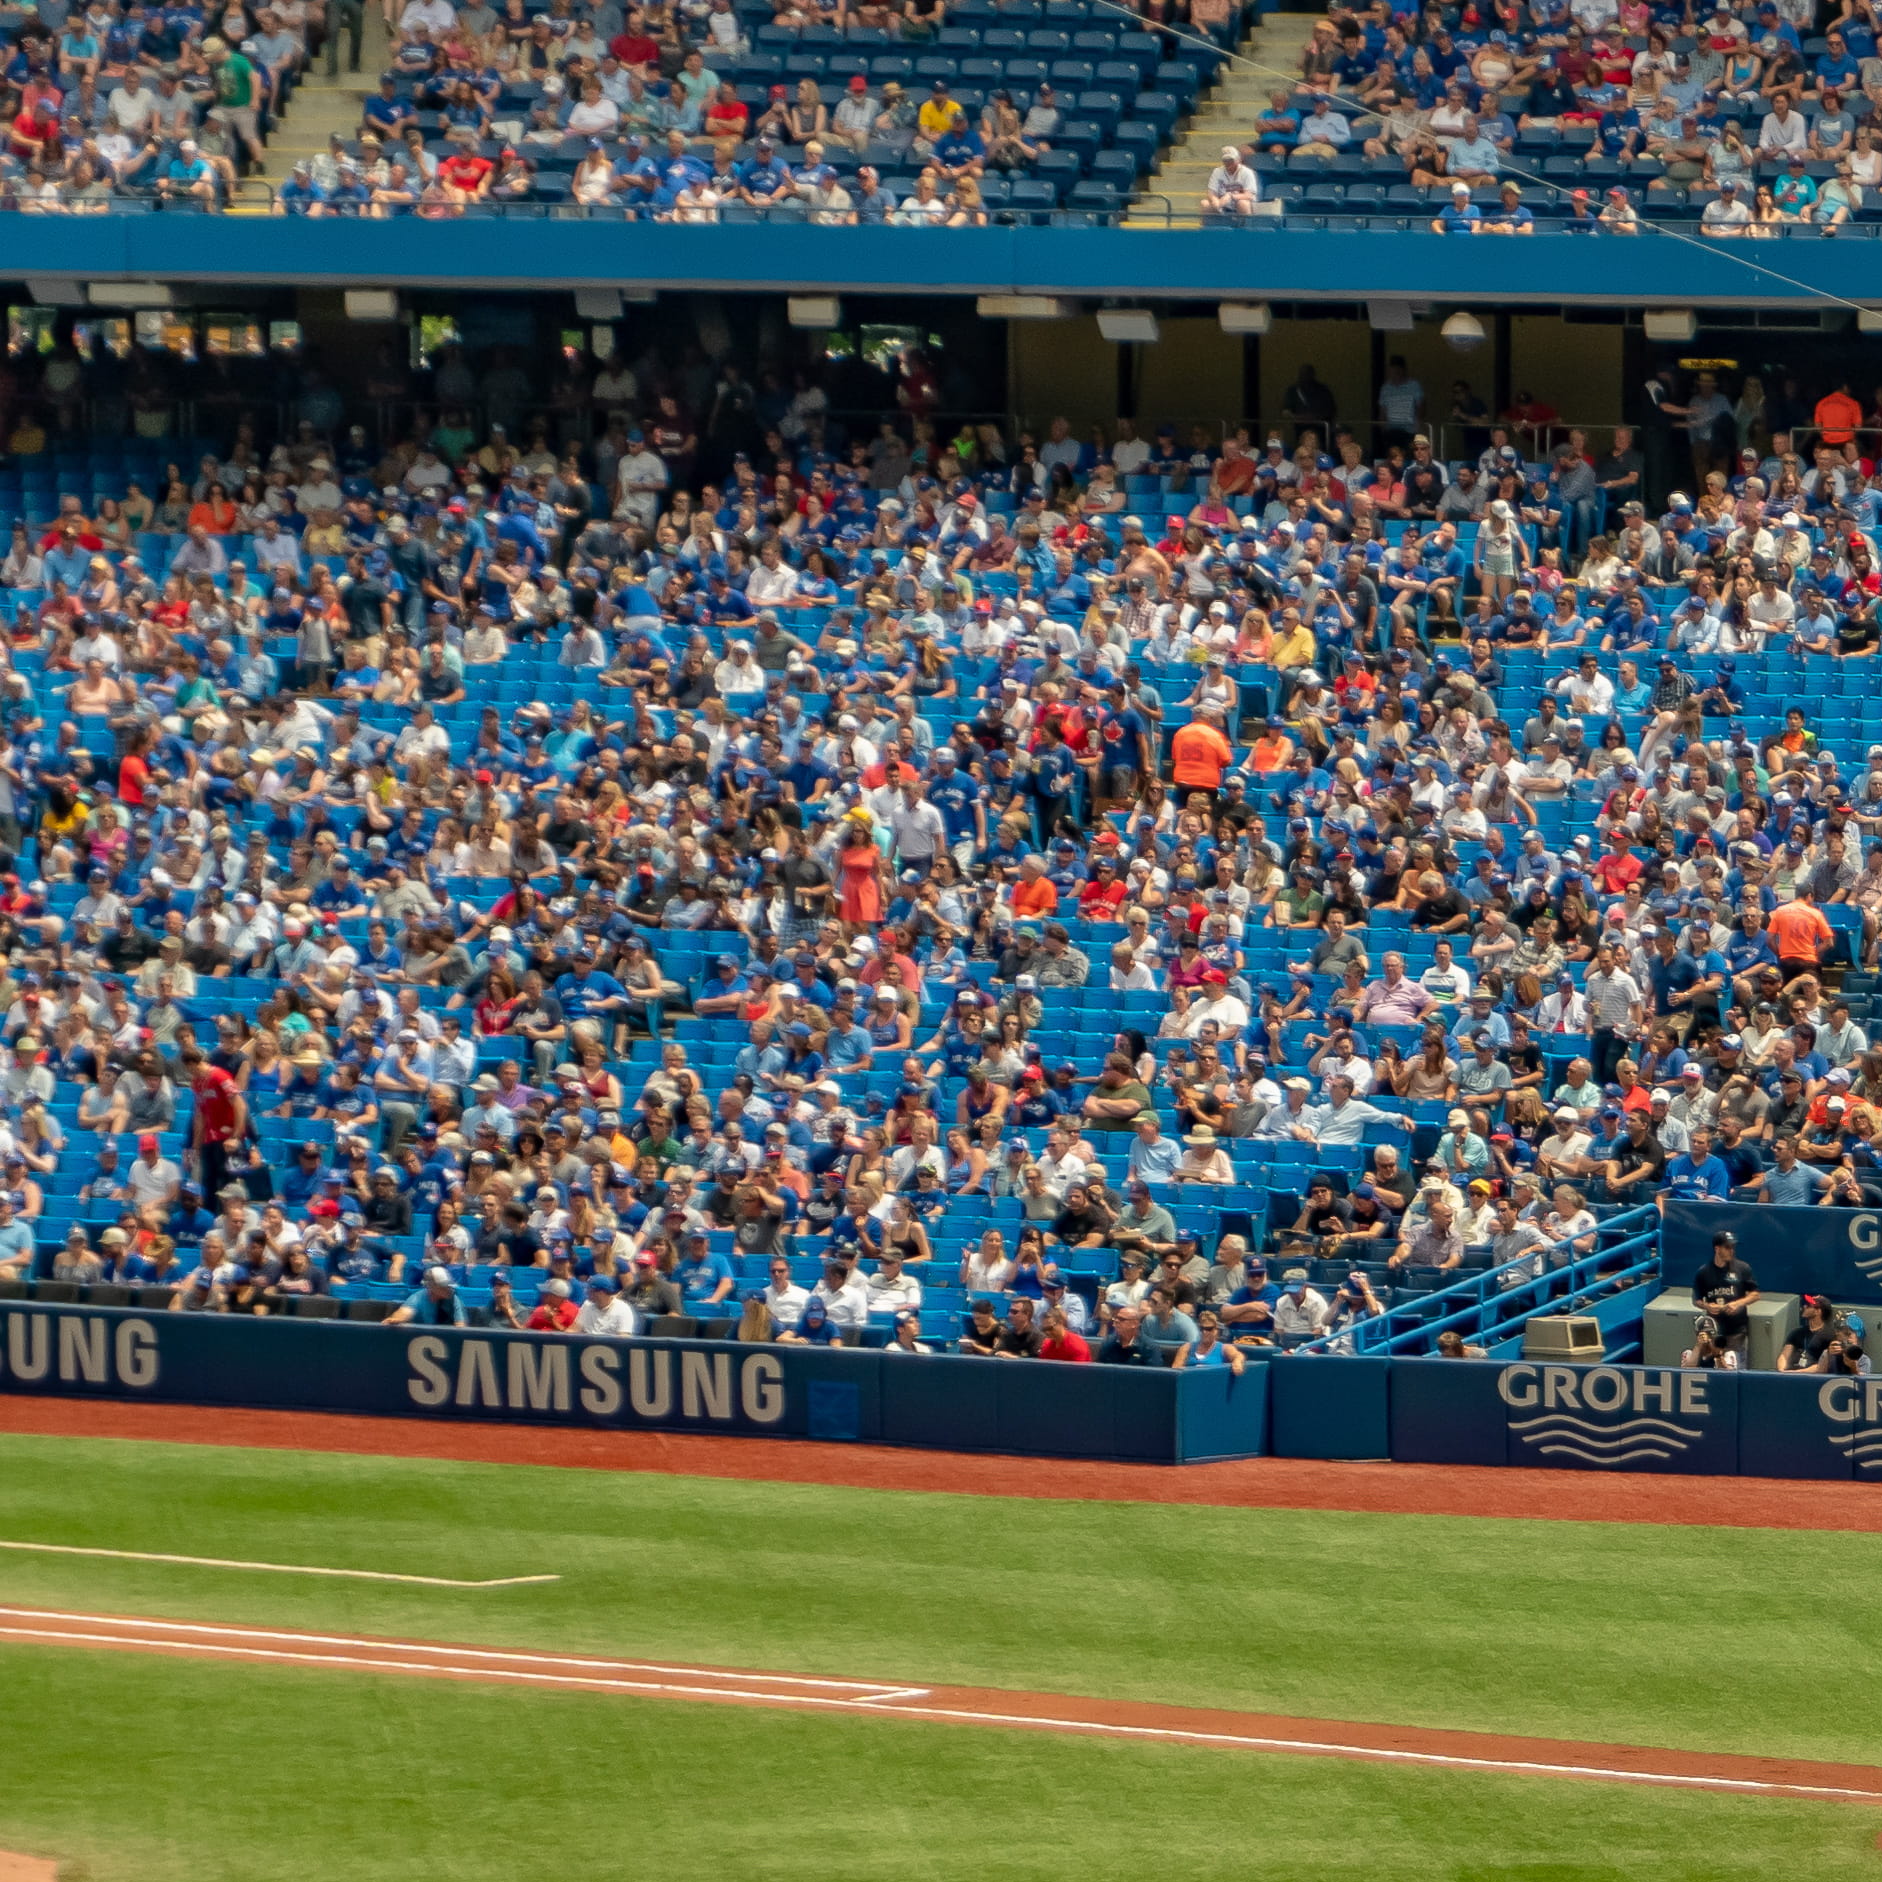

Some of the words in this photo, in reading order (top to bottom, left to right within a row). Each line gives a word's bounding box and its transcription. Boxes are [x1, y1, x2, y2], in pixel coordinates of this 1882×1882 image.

[0, 1312, 158, 1387] UNG
[408, 1335, 785, 1423] SAMSUNG
[1497, 1365, 1711, 1415] GROHE
